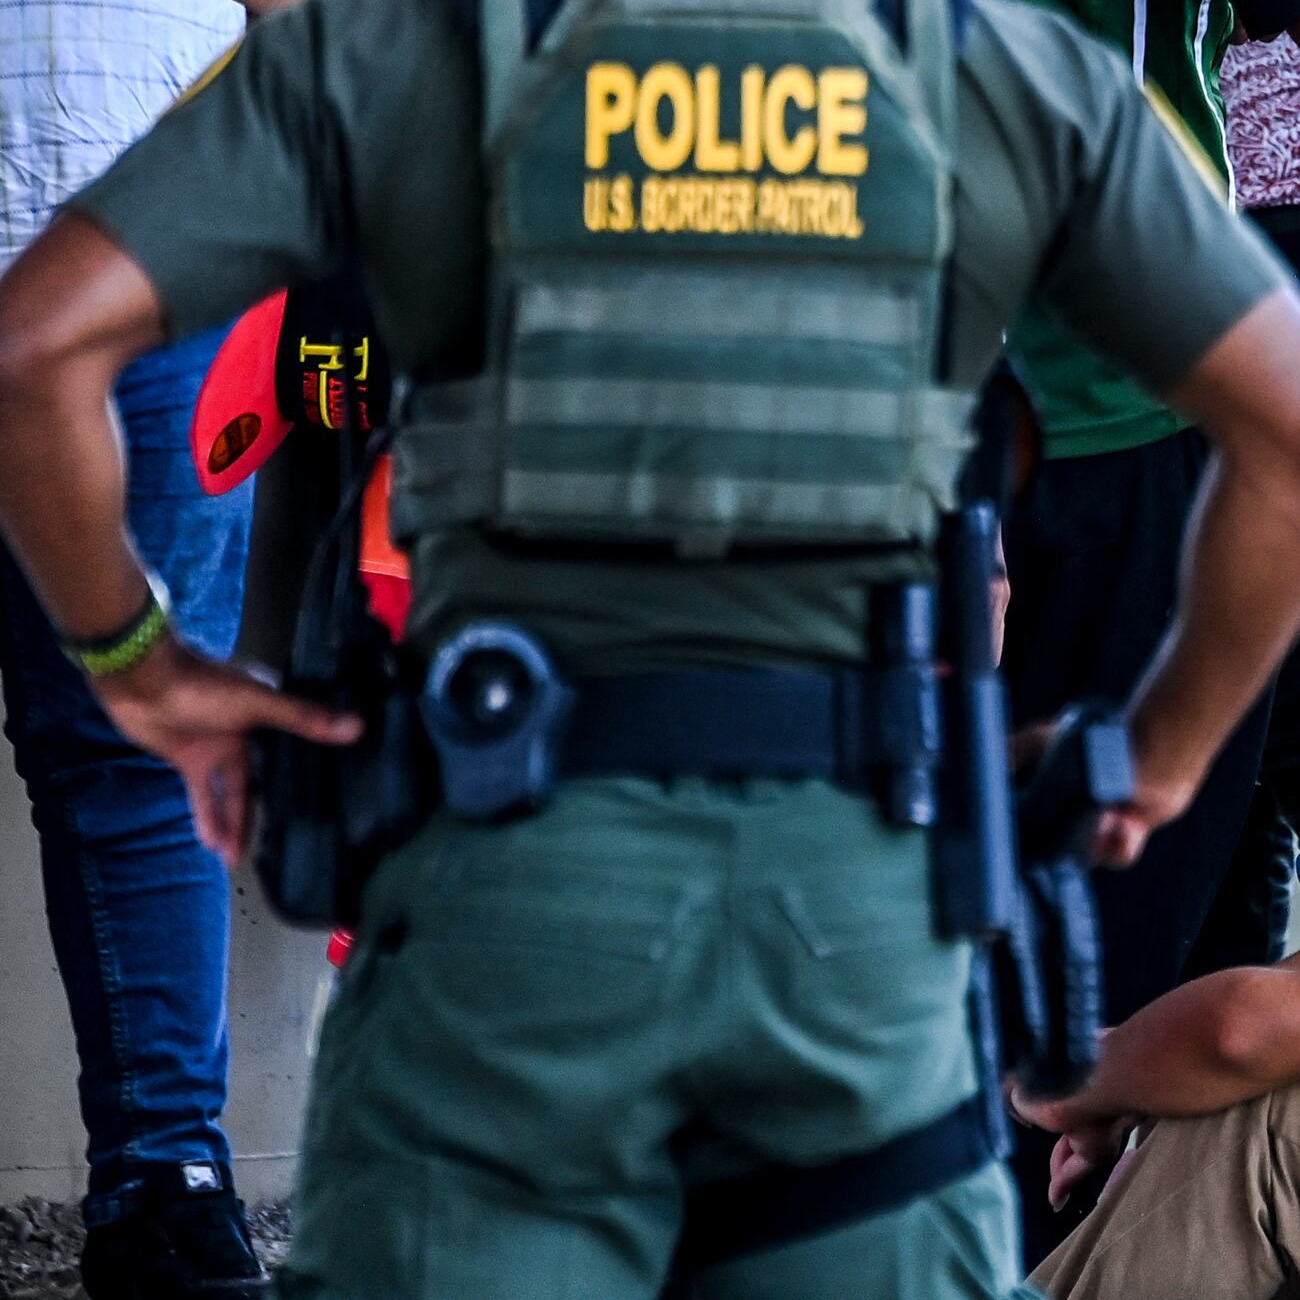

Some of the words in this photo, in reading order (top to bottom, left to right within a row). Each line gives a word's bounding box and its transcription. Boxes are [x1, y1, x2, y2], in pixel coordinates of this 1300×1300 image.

[584, 60, 869, 176] POLICE
[641, 174, 756, 233] BORDER
[758, 177, 865, 239] PATROL
